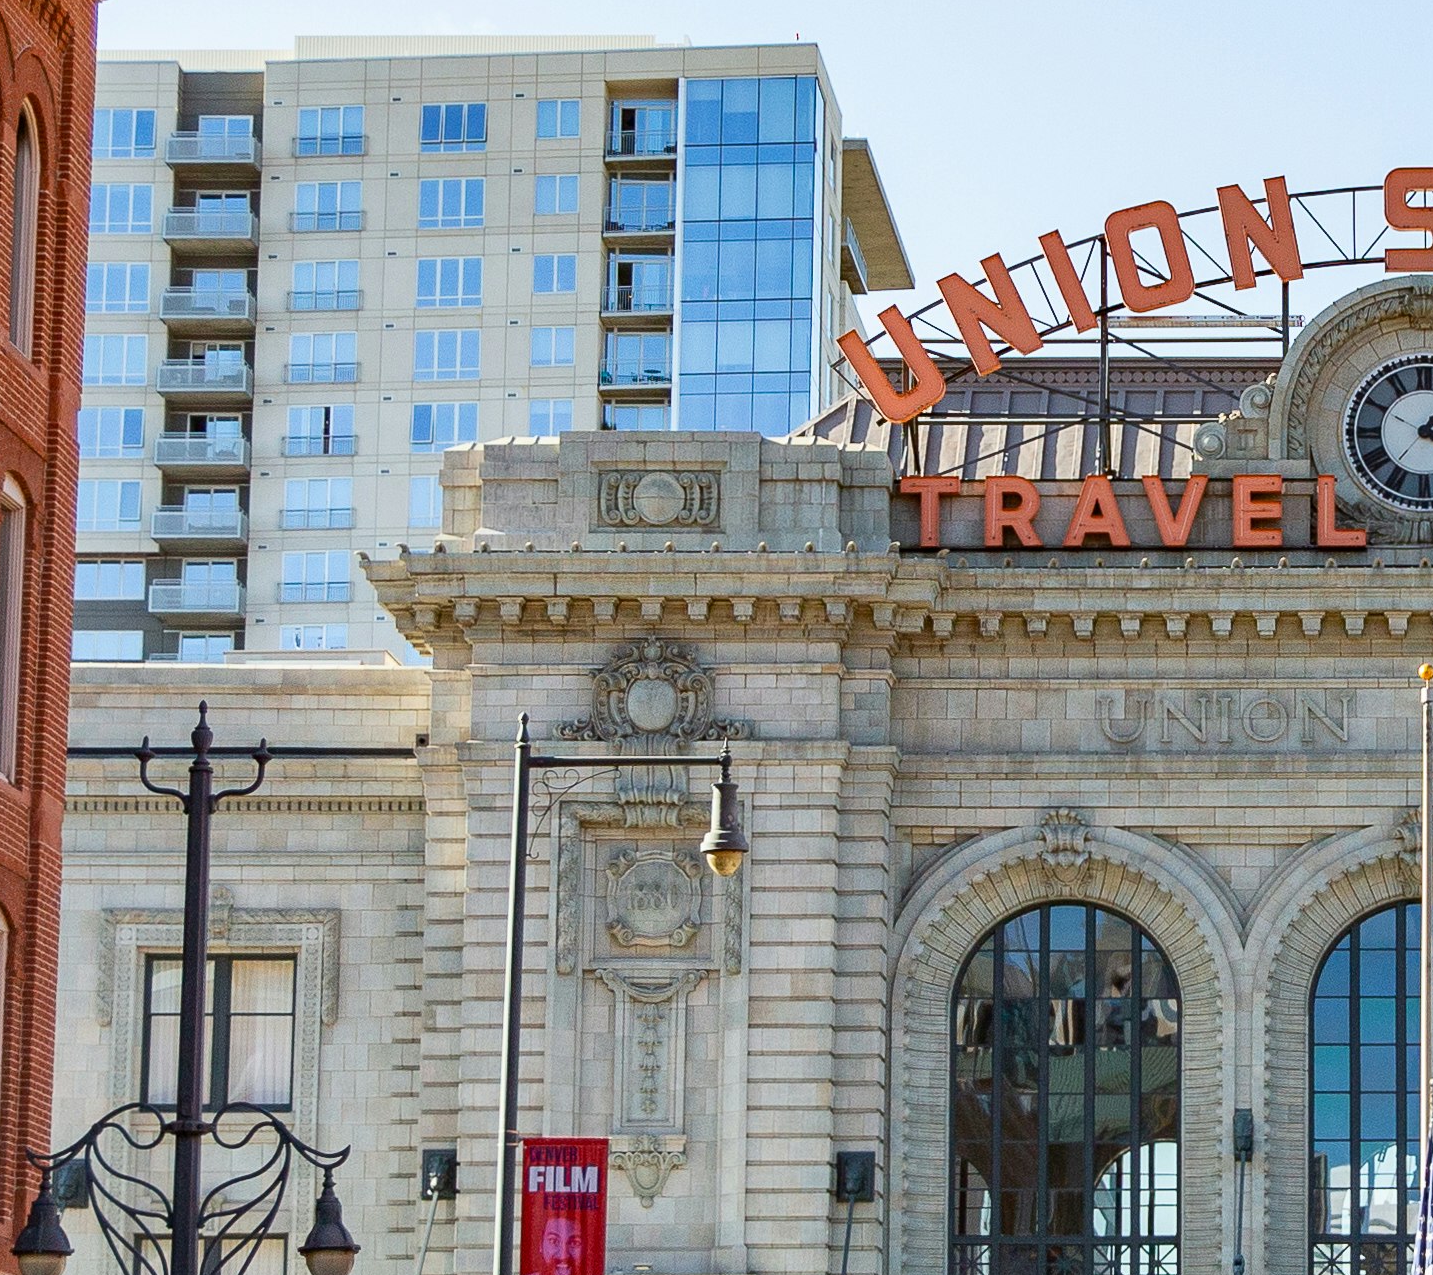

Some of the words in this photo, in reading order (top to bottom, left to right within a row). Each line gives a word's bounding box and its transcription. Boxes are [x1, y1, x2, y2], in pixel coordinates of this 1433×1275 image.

[837, 175, 1304, 424] UNION
[900, 474, 1367, 548] TRAVEL
[1097, 694, 1351, 744] UNION
[529, 1146, 579, 1163] DENVER
[528, 1165, 599, 1194] FILM
[543, 1195, 599, 1211] FESTIVAL
